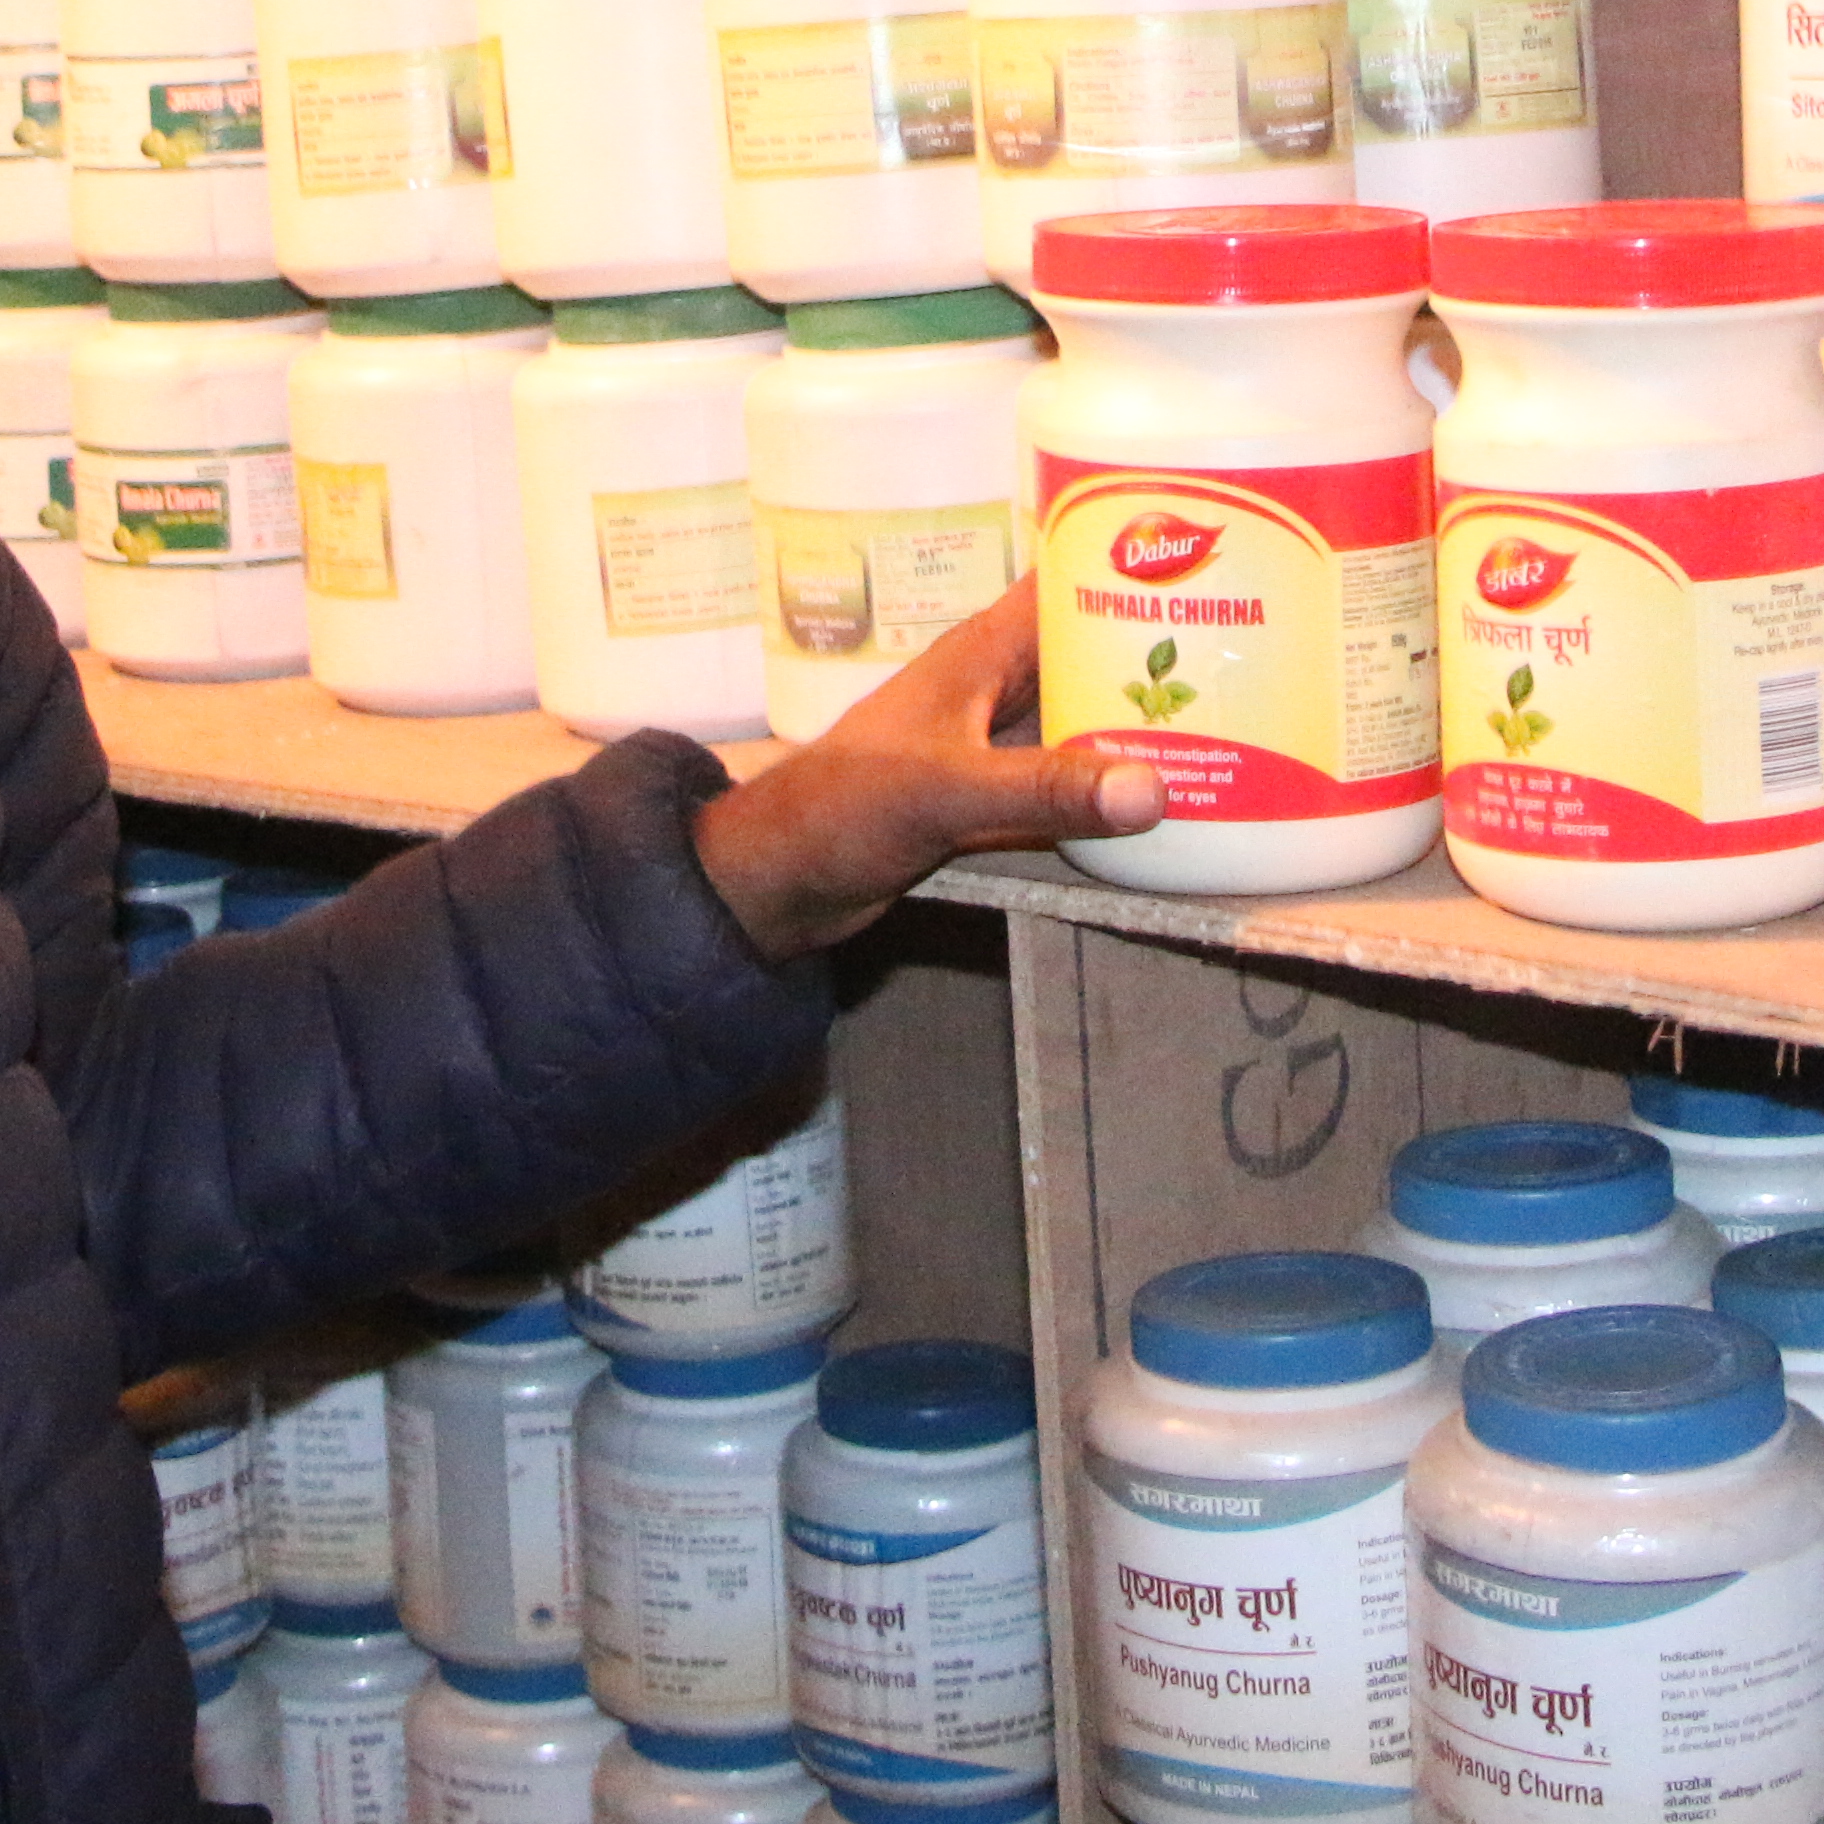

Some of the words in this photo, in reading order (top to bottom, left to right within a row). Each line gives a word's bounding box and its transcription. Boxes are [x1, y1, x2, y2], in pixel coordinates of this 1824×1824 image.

[1125, 534, 1200, 568] Dabur
[1484, 560, 1548, 594] डाबर
[1076, 586, 1163, 623] TRIPHALA
[1169, 596, 1265, 627] CHURNA
[1732, 601, 1754, 616] Keep
[1463, 605, 1532, 653] त्रिफला
[1544, 616, 1593, 666] चूर्ण
[1124, 743, 1160, 760] relieve
[1163, 746, 1242, 764] constipation,
[1210, 768, 1233, 783] and
[1169, 787, 1185, 802] for
[1188, 790, 1217, 805] eyes
[1131, 1482, 1262, 1517] सगरमाथा
[1118, 1562, 1225, 1627] पुष्यानुग
[1236, 1576, 1298, 1632] चूर्ण
[1433, 1559, 1561, 1617] सगरमाथा
[1120, 1643, 1219, 1699] Pushyanug
[1226, 1669, 1312, 1697] Churna
[1423, 1640, 1519, 1717] पुष्यानुग
[1530, 1683, 1594, 1737] चूर्ण
[1661, 1688, 1685, 1702] Pain
[1176, 1727, 1250, 1753] Ayurvedic
[1255, 1735, 1332, 1753] Medicine
[1677, 1736, 1722, 1753] directed
[1161, 1773, 1195, 1791] MADE
[1198, 1780, 1212, 1794] IN
[1214, 1781, 1260, 1799] NEPAL
[1518, 1768, 1604, 1807] Churna
[1665, 1776, 1713, 1794] उपयोग
